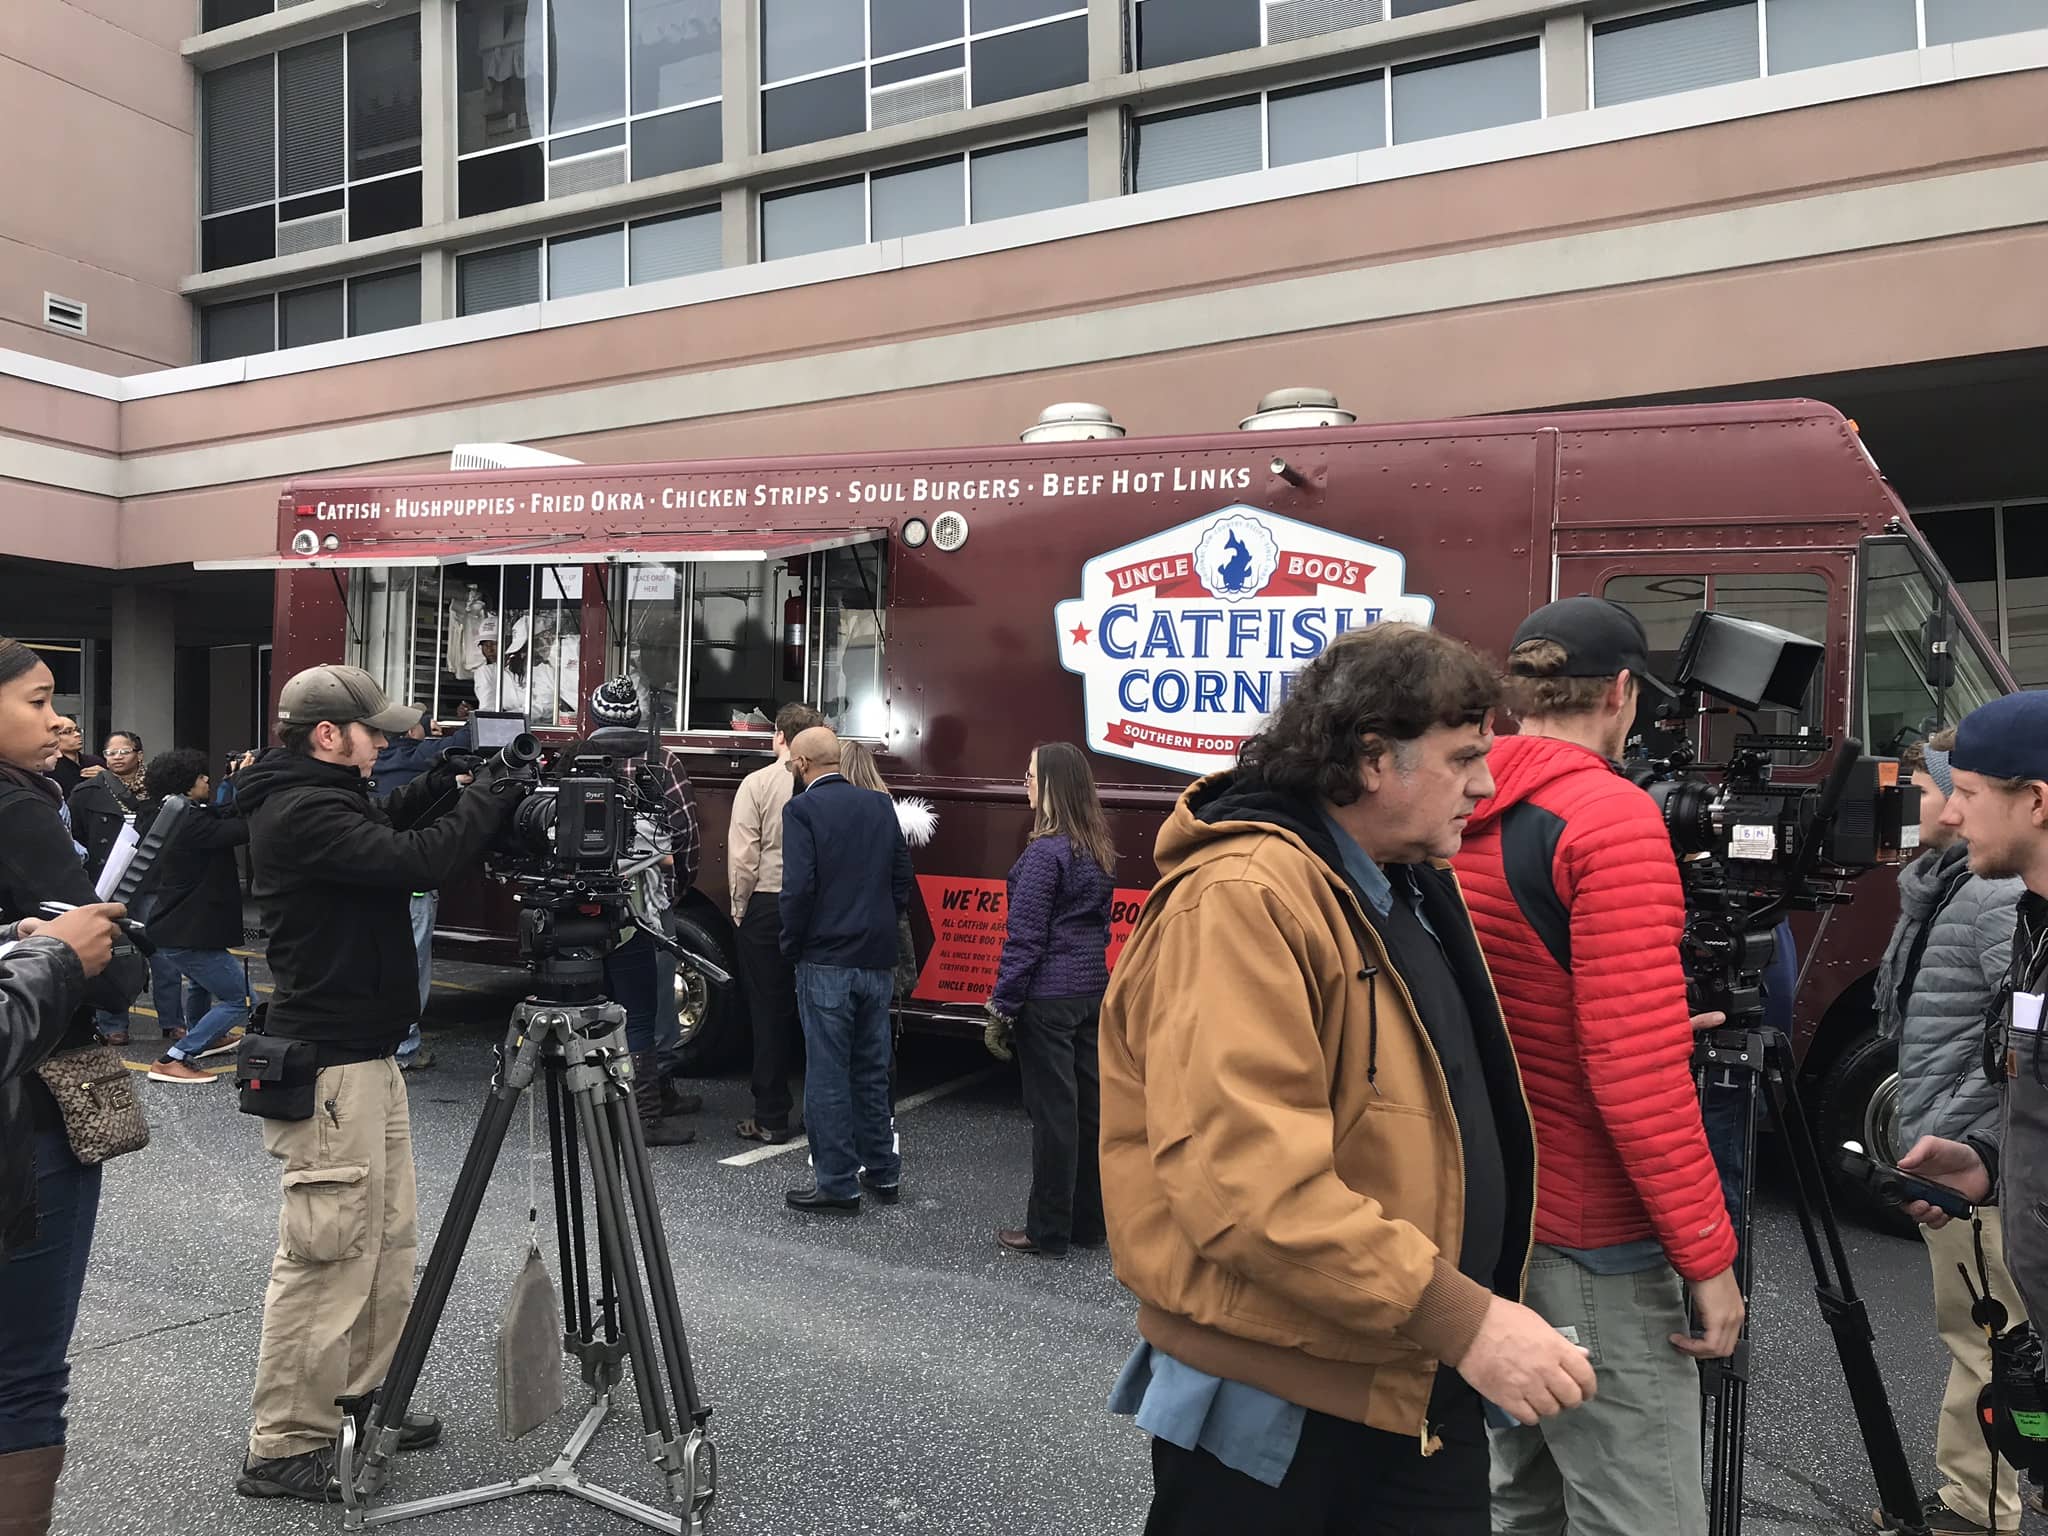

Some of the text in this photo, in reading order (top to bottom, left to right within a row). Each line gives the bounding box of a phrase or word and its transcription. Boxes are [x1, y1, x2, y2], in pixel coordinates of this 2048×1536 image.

[317, 467, 1250, 521] CATFISH HUSHPUPPIES FRIED OKRA CHICKEN STRIPS SOUL BURGERS BEEF HOT LINKS
[1117, 558, 1189, 589] UNCLE
[1288, 556, 1359, 585] BOO'S
[1123, 725, 1192, 748] SOUTHERN
[1196, 738, 1234, 751] FOOD
[1785, 825, 1794, 854] RED
[942, 888, 1004, 912] WE'RE
[938, 980, 993, 994] UNCLE BOO'S
